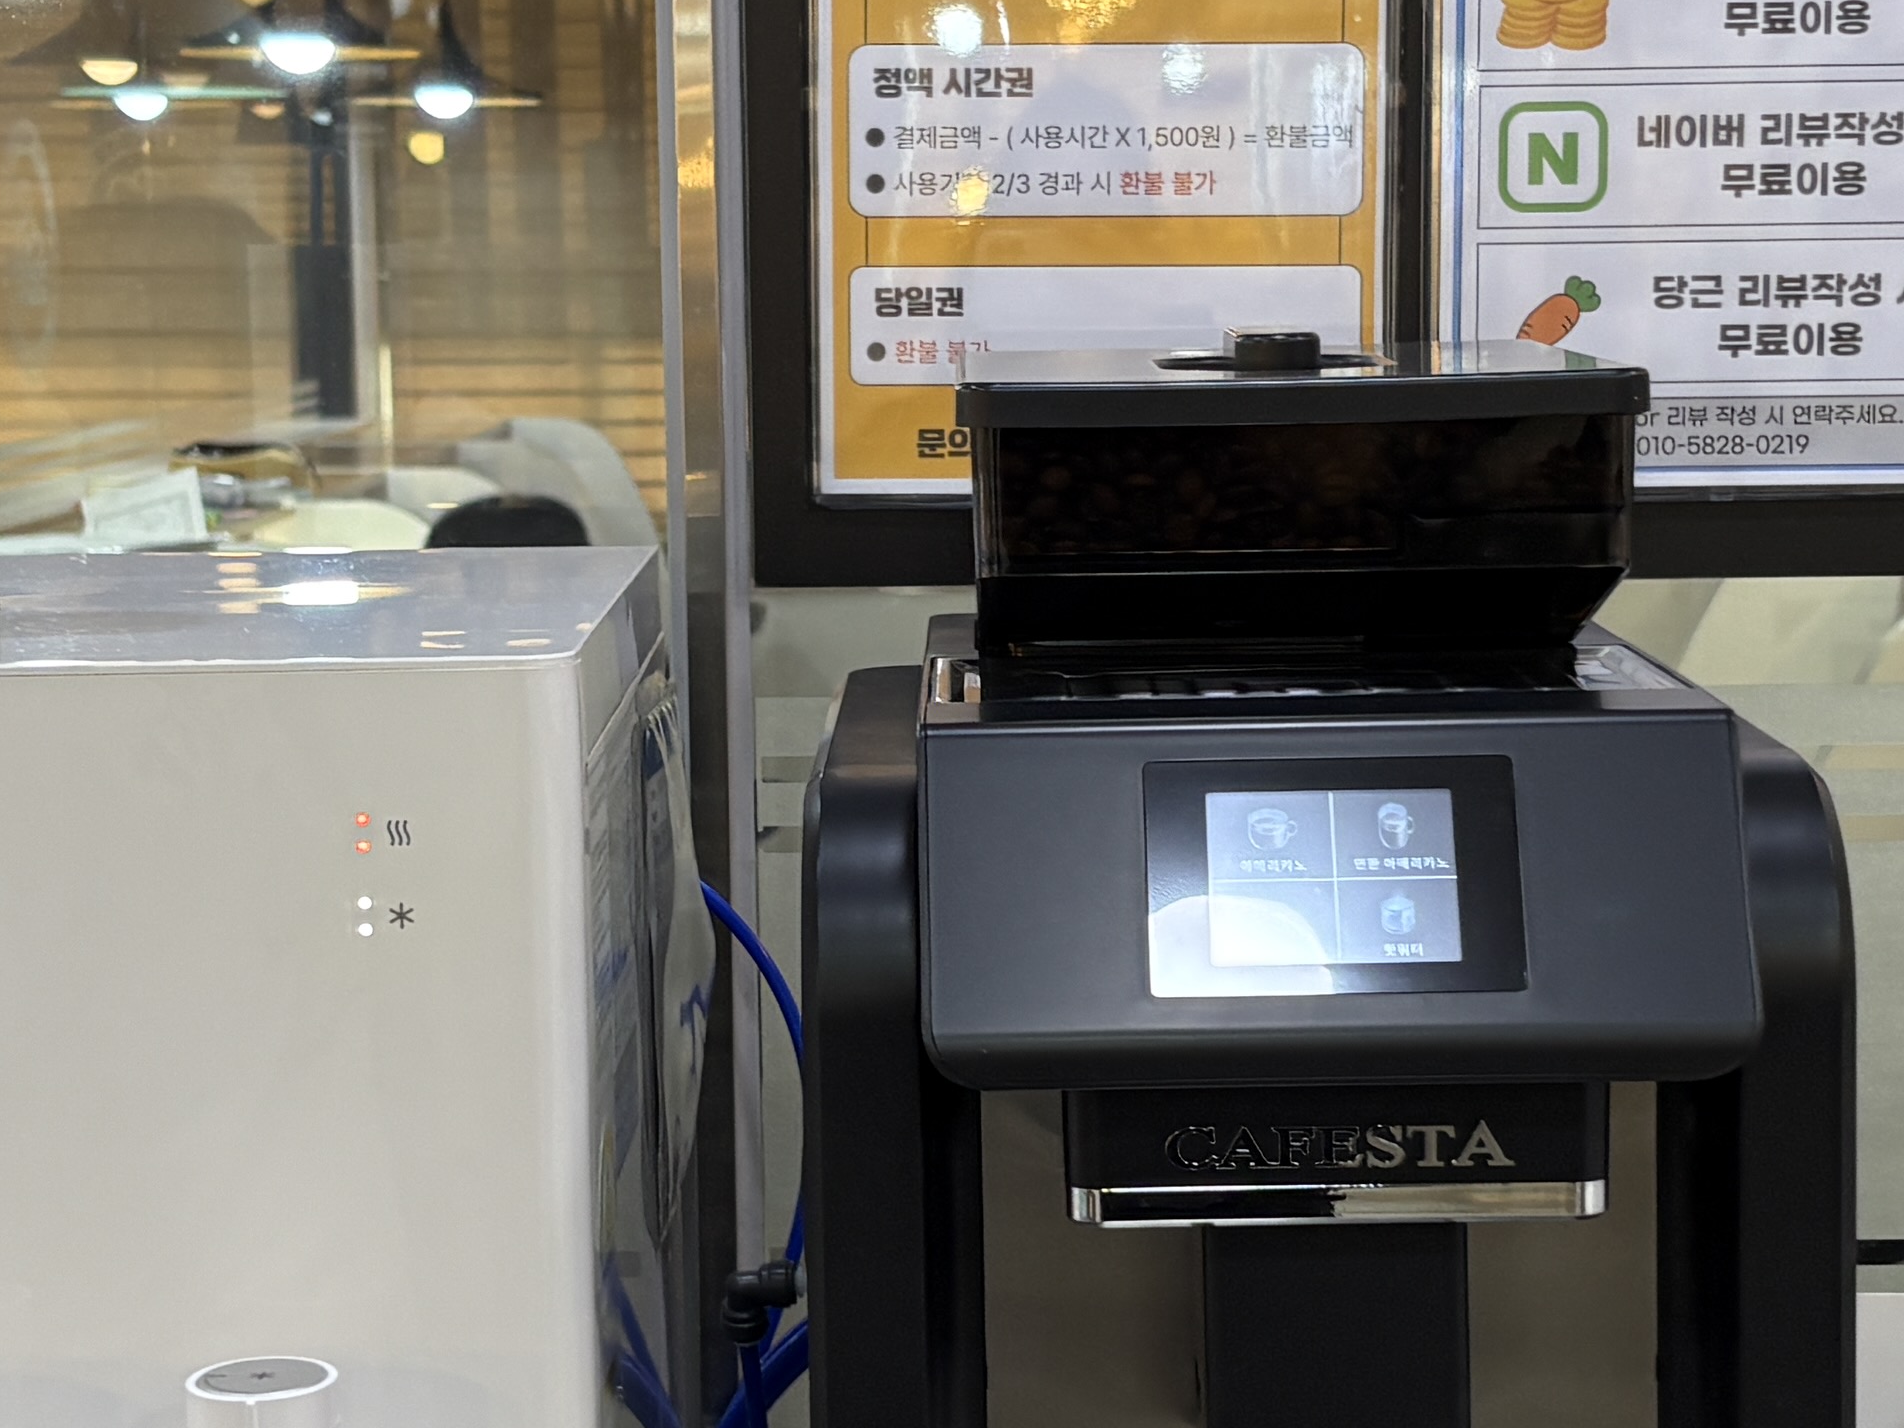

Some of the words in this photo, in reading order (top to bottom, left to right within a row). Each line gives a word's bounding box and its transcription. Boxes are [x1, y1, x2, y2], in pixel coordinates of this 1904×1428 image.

[1724, 0, 1871, 36] 무료이용
[872, 68, 934, 99] 정액
[943, 67, 1034, 99] 시간권
[893, 126, 983, 151] 결제금액
[1020, 125, 1110, 150] 사용시간
[1116, 127, 1132, 149] X
[1137, 125, 1222, 153] 1,500원
[1264, 124, 1354, 149] 환불금액
[1636, 112, 1746, 149] 네이버
[1760, 111, 1904, 147] 리뷰작성
[992, 173, 1031, 196] 2/3
[1038, 171, 1084, 196] 경과
[1091, 171, 1113, 196] 시
[1119, 171, 1165, 196] 환불
[1172, 170, 1216, 195] 불가
[1720, 161, 1867, 198] 무료이용
[874, 286, 965, 317] 당일권
[1652, 274, 1723, 310] 당근
[1738, 272, 1883, 308] 리뷰작성
[896, 340, 938, 364] 환불
[1718, 322, 1863, 359] 무료이용
[1668, 407, 1708, 426] 리뷰
[1716, 406, 1756, 426] 작성
[1765, 406, 1784, 424] 시
[1792, 404, 1904, 425] 연락주세요.
[1636, 434, 1810, 455] 010-5828-0219
[1164, 1118, 1515, 1171] CAFESTA
